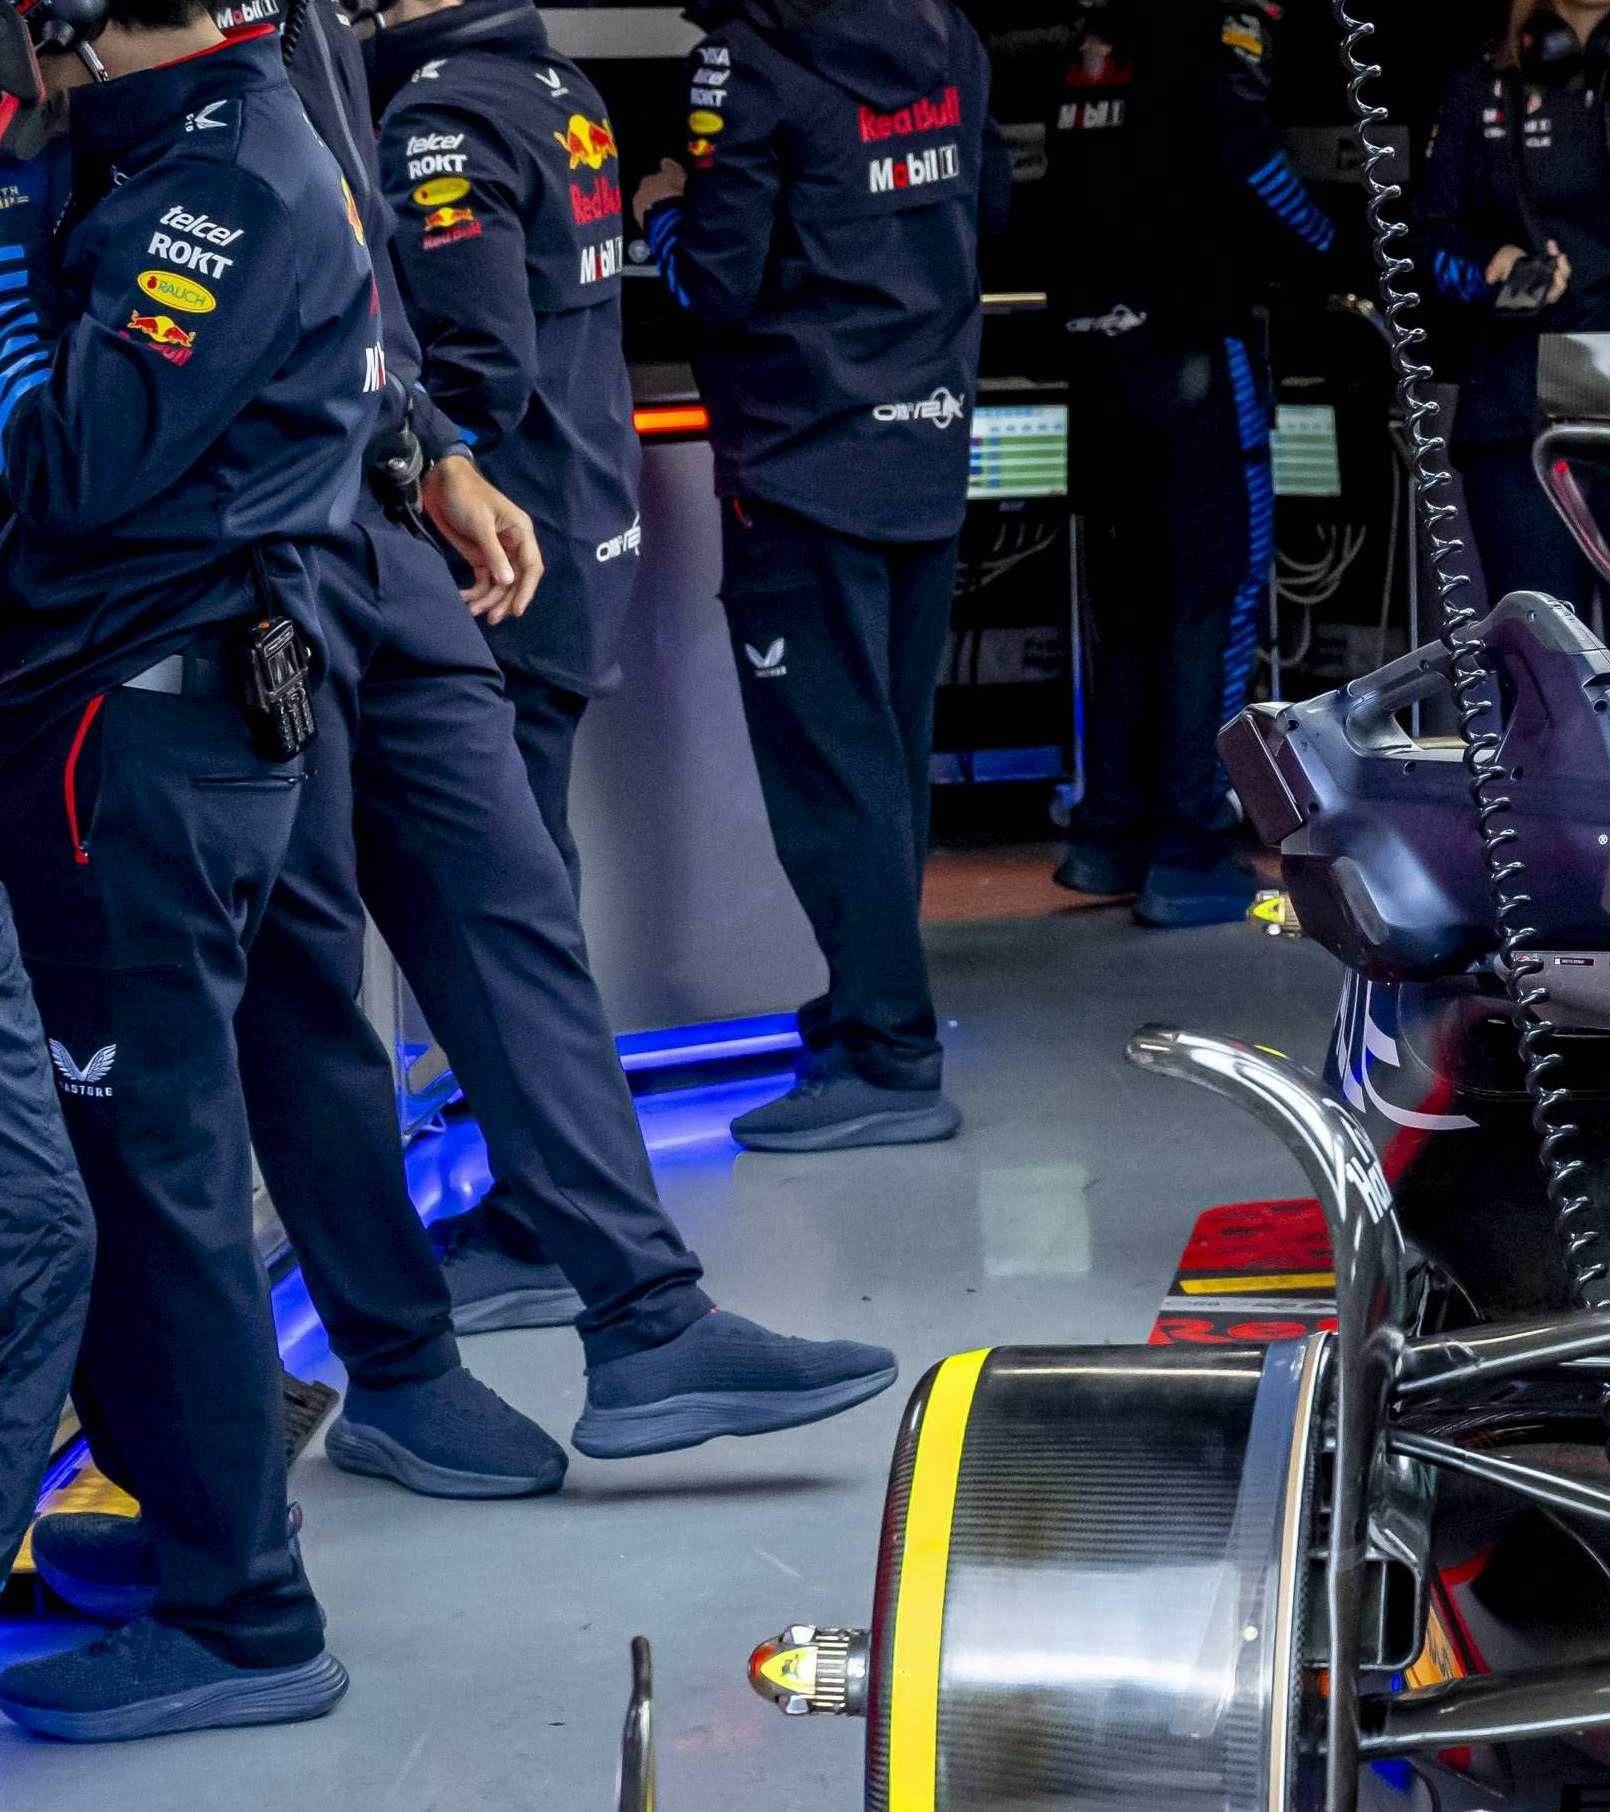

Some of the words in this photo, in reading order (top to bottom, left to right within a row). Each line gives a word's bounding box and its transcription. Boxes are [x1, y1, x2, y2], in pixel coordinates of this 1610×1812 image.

[407, 153, 467, 180] ROKT
[869, 149, 938, 193] Mobil
[159, 205, 244, 246] telcel
[147, 231, 234, 280] ROKT
